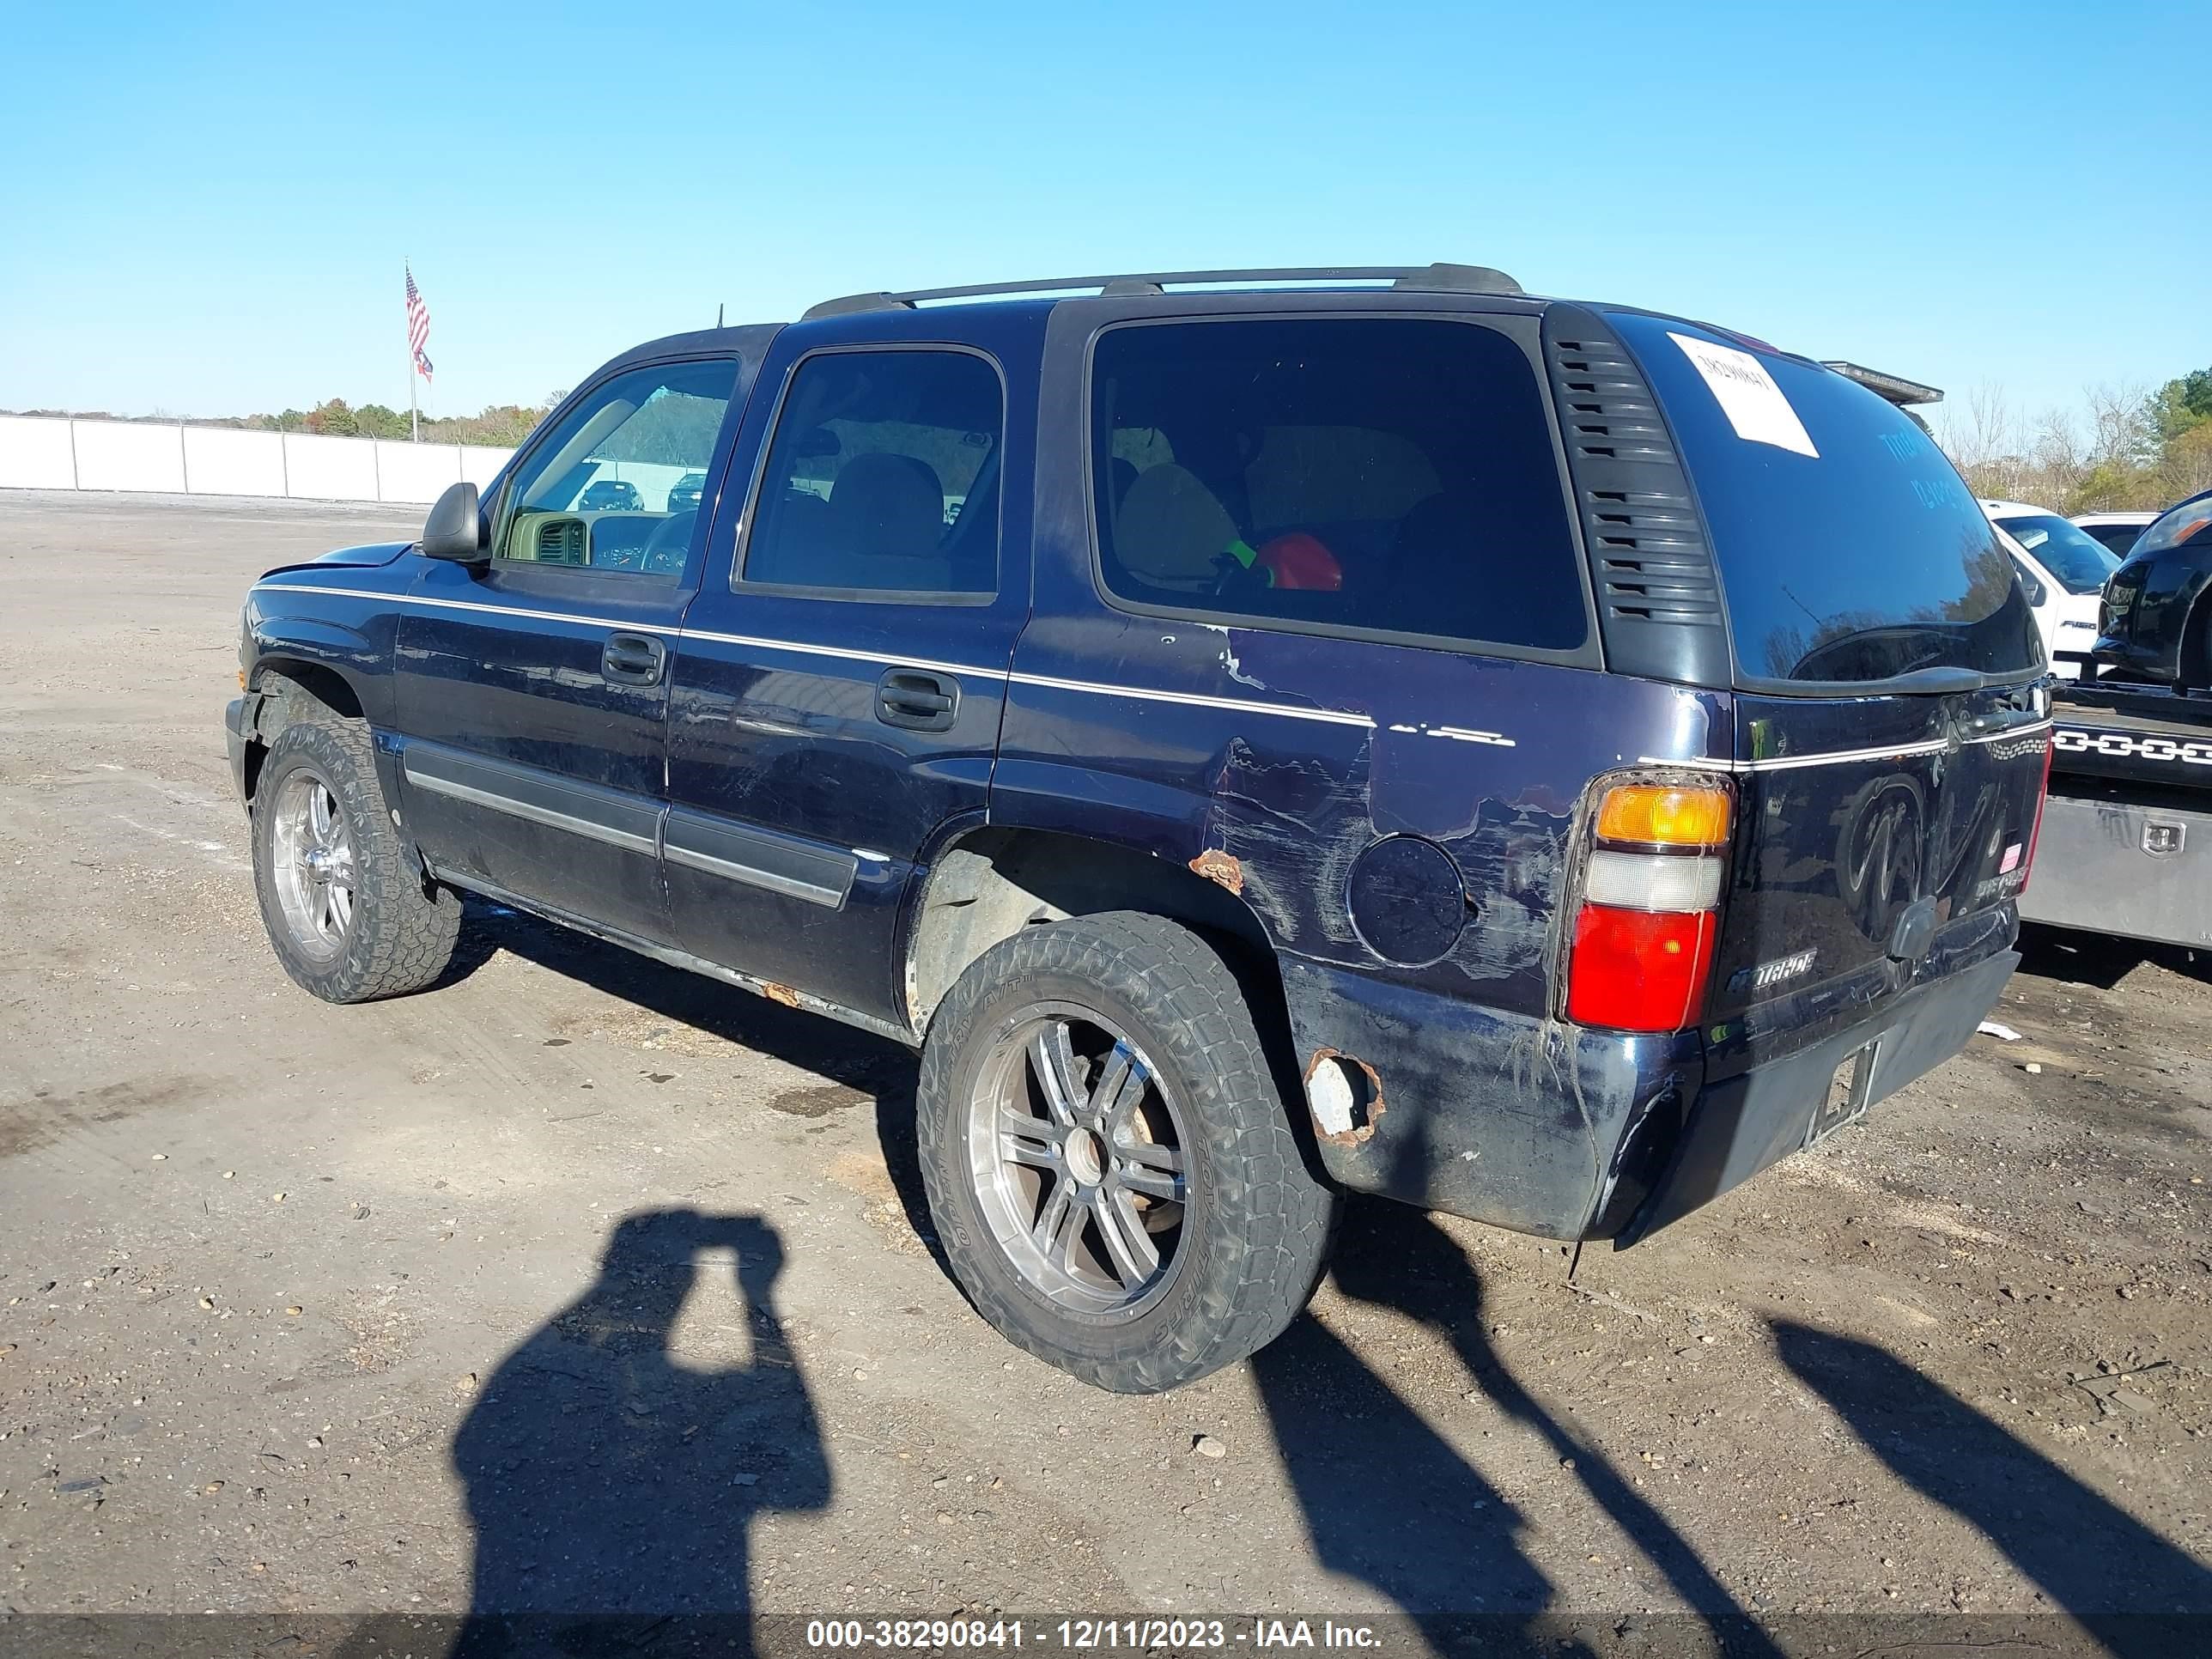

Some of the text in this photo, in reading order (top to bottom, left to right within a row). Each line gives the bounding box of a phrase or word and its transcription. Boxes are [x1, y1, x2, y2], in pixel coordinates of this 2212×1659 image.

[1697, 355, 1770, 391] 38290841
[1756, 951, 1816, 988] TAHOE
[938, 1158, 972, 1247] OPEN
[1154, 1135, 1215, 1345] TOYO TIRES
